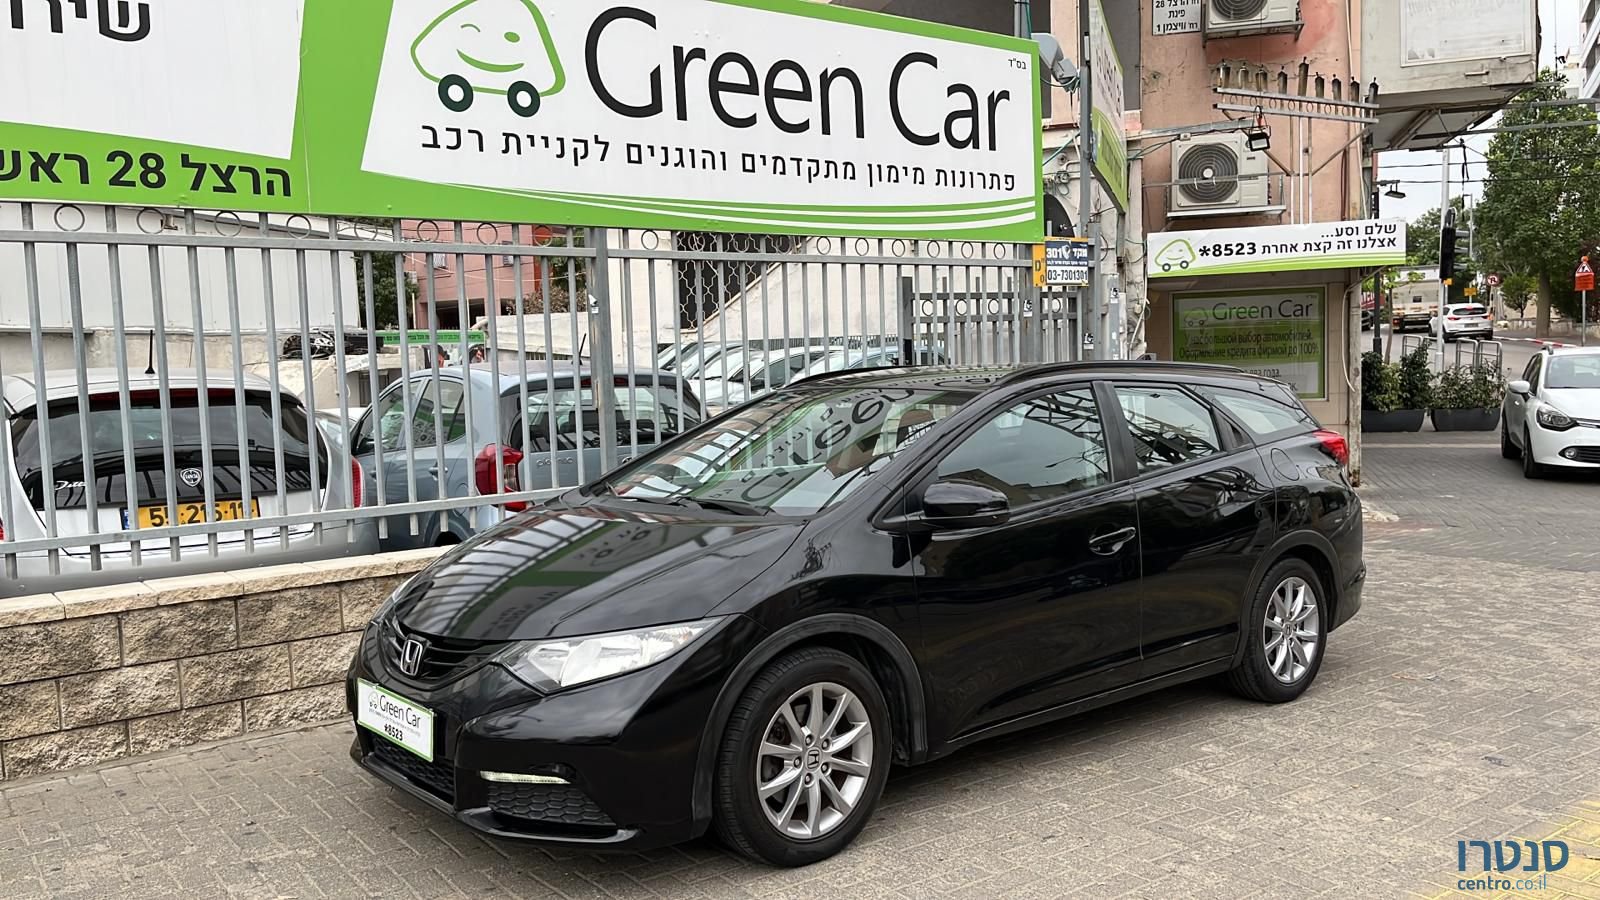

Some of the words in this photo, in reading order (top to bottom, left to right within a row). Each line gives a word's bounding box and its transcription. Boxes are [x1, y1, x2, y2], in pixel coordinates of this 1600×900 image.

[1155, 0, 1165, 8] 28
[1168, 9, 1186, 18] פינת
[1156, 24, 1161, 32] 1
[1008, 58, 1027, 69] בס"ד
[584, 6, 865, 139] Green
[889, 52, 1010, 152] Car
[421, 124, 485, 153] רכב
[501, 131, 610, 167] לקניית
[626, 142, 728, 171] והוגנים
[106, 150, 167, 189] 28
[741, 152, 857, 184] מתקדמים
[180, 153, 291, 198] הרצל
[867, 163, 925, 188] מימון
[935, 168, 1015, 191] פתרונות
[1321, 226, 1360, 238] וסע...
[1365, 223, 1397, 235] שלם
[1261, 242, 1298, 255] אחרת
[1303, 239, 1332, 254] קצת
[1336, 238, 1353, 251] זה
[1357, 236, 1397, 249] אצלנו
[1046, 247, 1063, 259] 301
[1212, 302, 1273, 320] Green
[1278, 299, 1313, 318] Car
[1237, 332, 1262, 346] выбор
[1287, 344, 1298, 357] до
[379, 695, 405, 721] Green
[405, 707, 421, 729] Car
